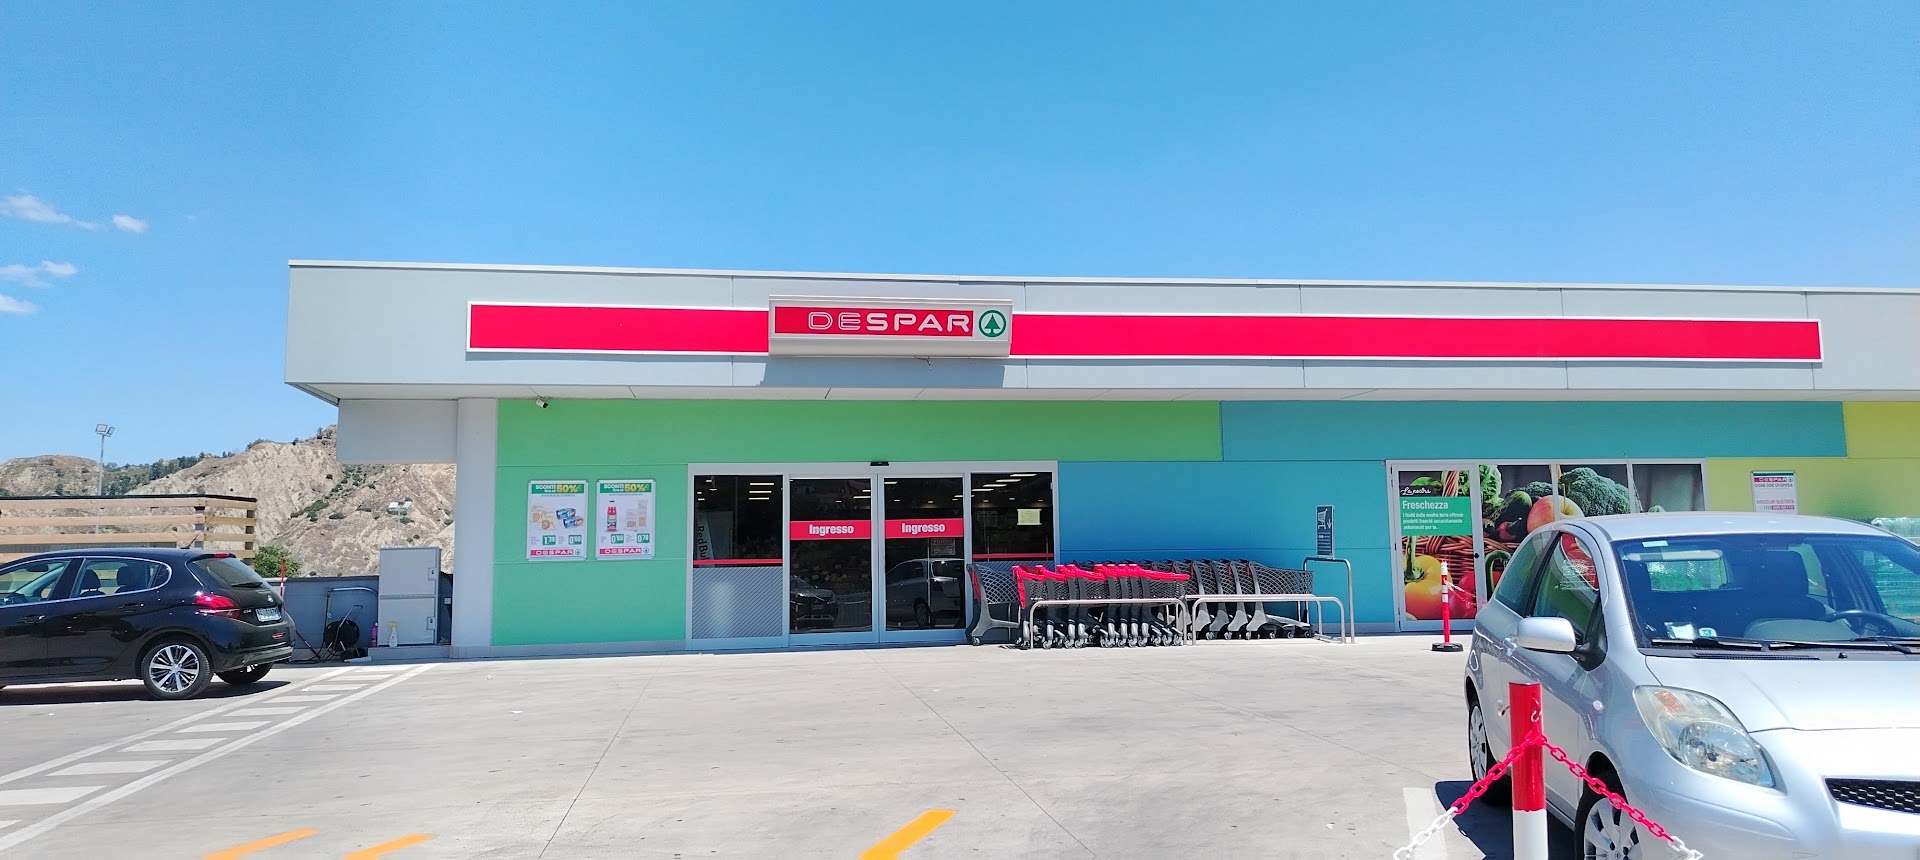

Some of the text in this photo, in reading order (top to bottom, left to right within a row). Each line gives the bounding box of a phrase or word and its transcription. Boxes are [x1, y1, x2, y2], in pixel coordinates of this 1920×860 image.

[808, 311, 970, 333] DESPAR
[556, 484, 578, 493] 50%
[624, 483, 646, 492] 50%
[1402, 500, 1449, 510] Freschezza
[809, 524, 854, 536] Ingresso
[901, 523, 946, 535] Ingresso
